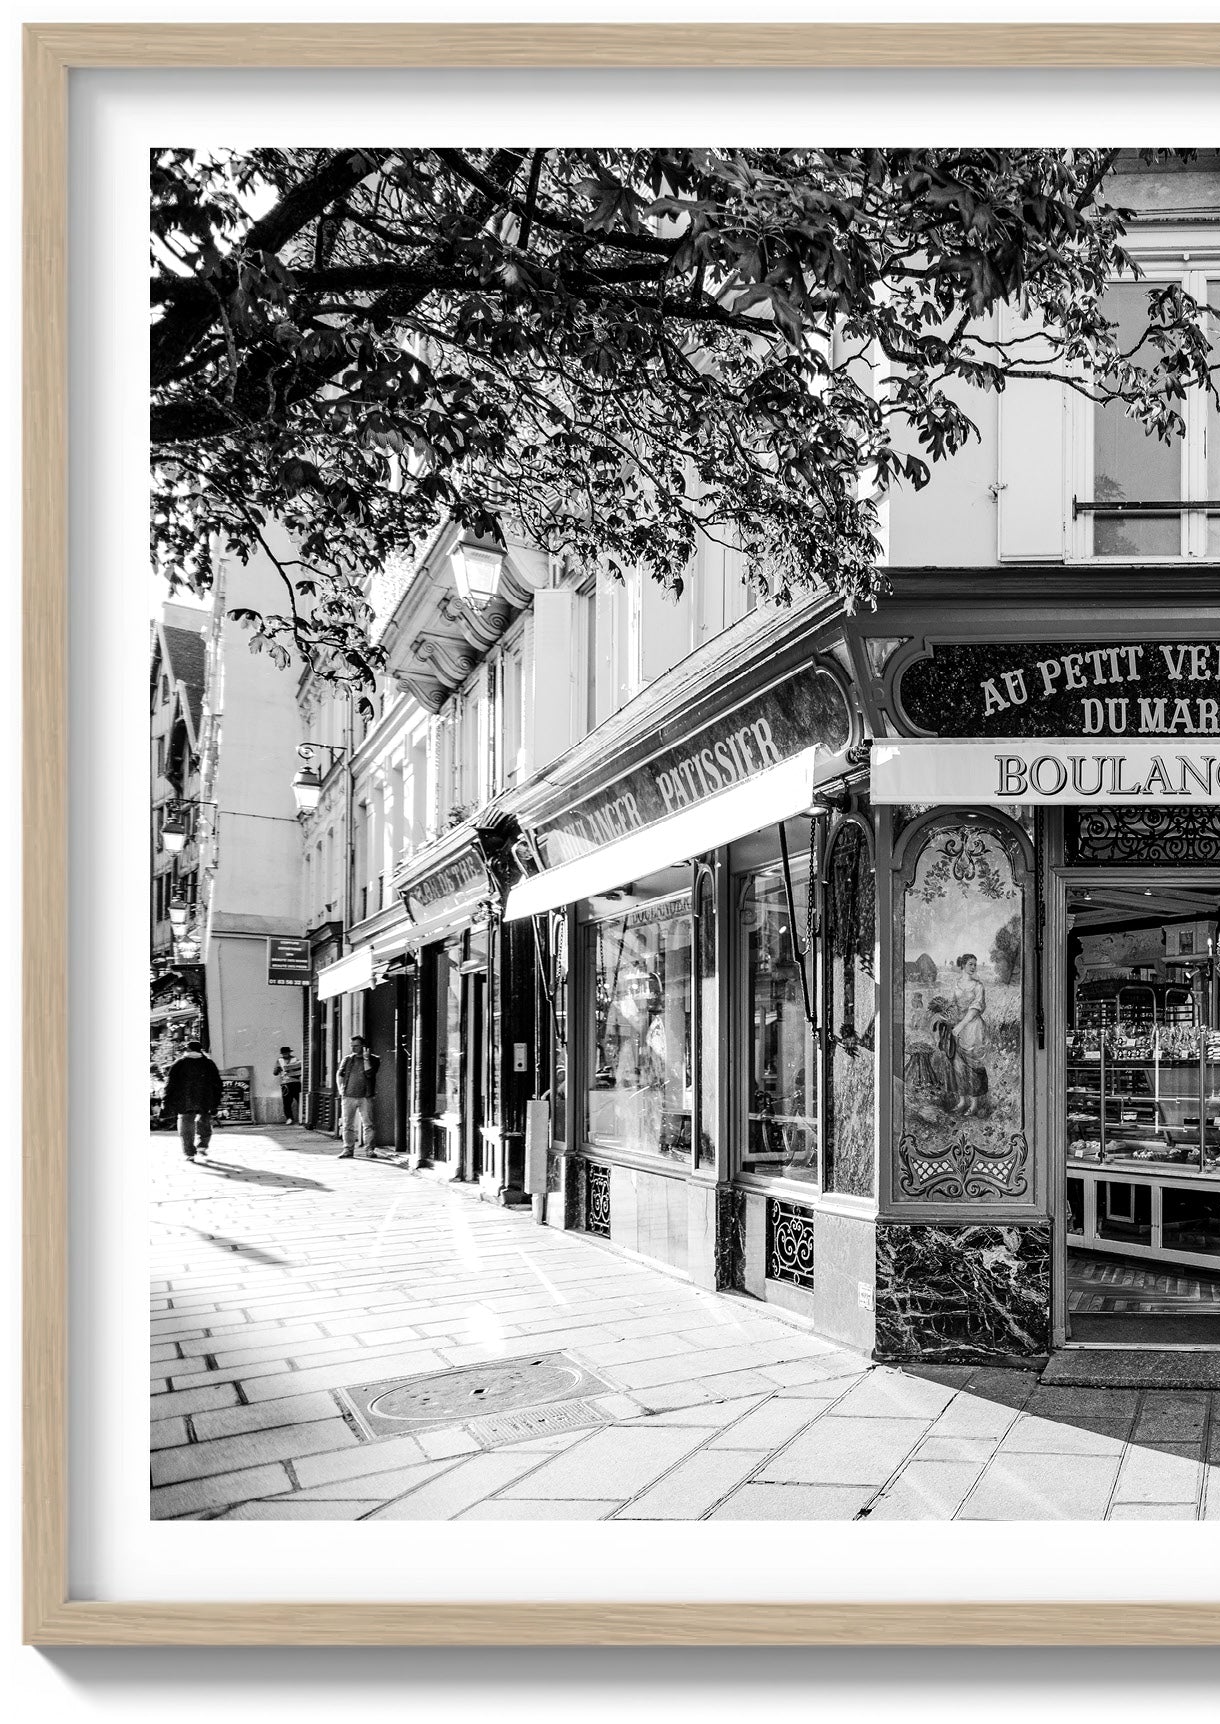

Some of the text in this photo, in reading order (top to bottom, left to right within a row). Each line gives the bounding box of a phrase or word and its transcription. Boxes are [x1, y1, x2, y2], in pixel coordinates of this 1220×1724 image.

[980, 668, 1028, 717] AU
[1037, 645, 1144, 696] PETIT
[1080, 698, 1130, 734] DU
[655, 717, 783, 814] PATISSIER
